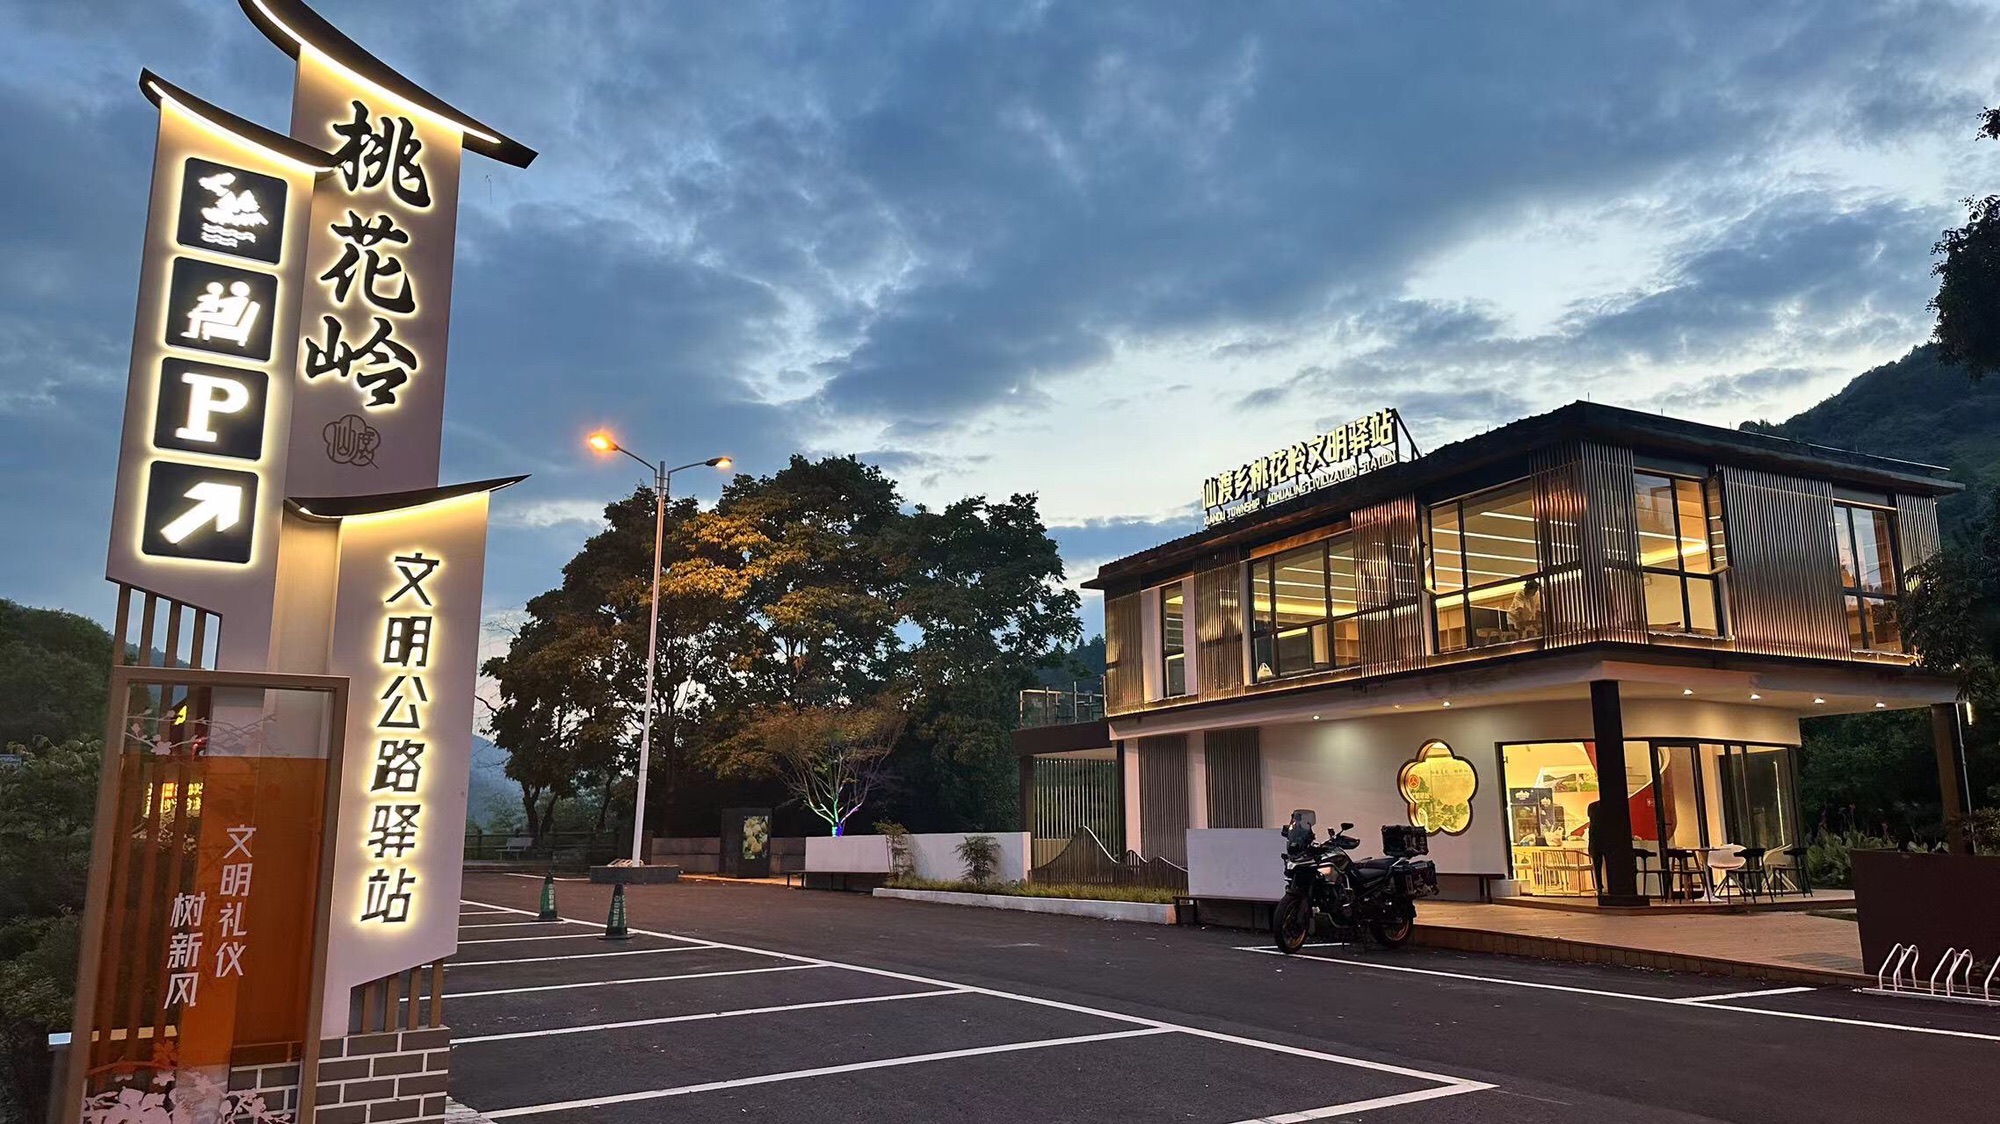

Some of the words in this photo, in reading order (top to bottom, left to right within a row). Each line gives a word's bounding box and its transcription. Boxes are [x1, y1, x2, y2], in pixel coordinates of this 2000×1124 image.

[305, 100, 432, 408] 桃花岭
[175, 372, 249, 443] P
[1359, 450, 1396, 474] STATION
[361, 552, 440, 924] 文明公路驿站
[163, 891, 206, 1010] 树新风
[216, 824, 257, 978] 文明礼仪
